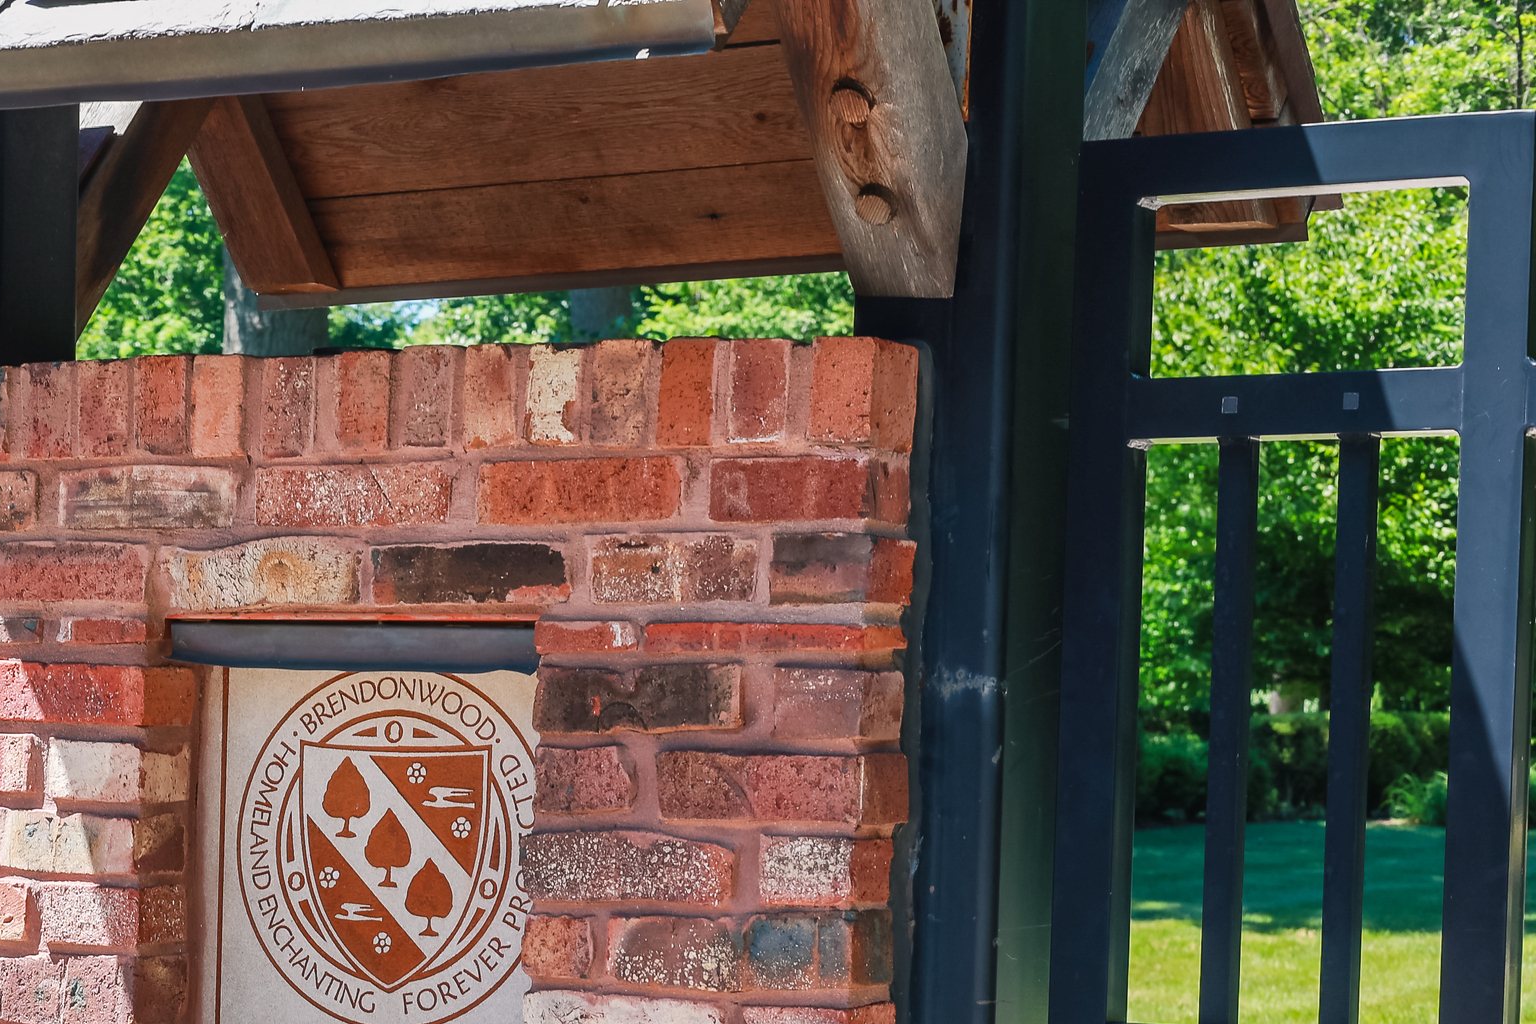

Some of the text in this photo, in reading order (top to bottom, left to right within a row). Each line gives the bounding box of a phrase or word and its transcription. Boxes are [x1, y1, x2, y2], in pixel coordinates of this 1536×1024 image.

[299, 676, 497, 741] BRENDONWOOD
[249, 740, 535, 1015] HOMELAND ENCHANTING FOREVER PROCTED
